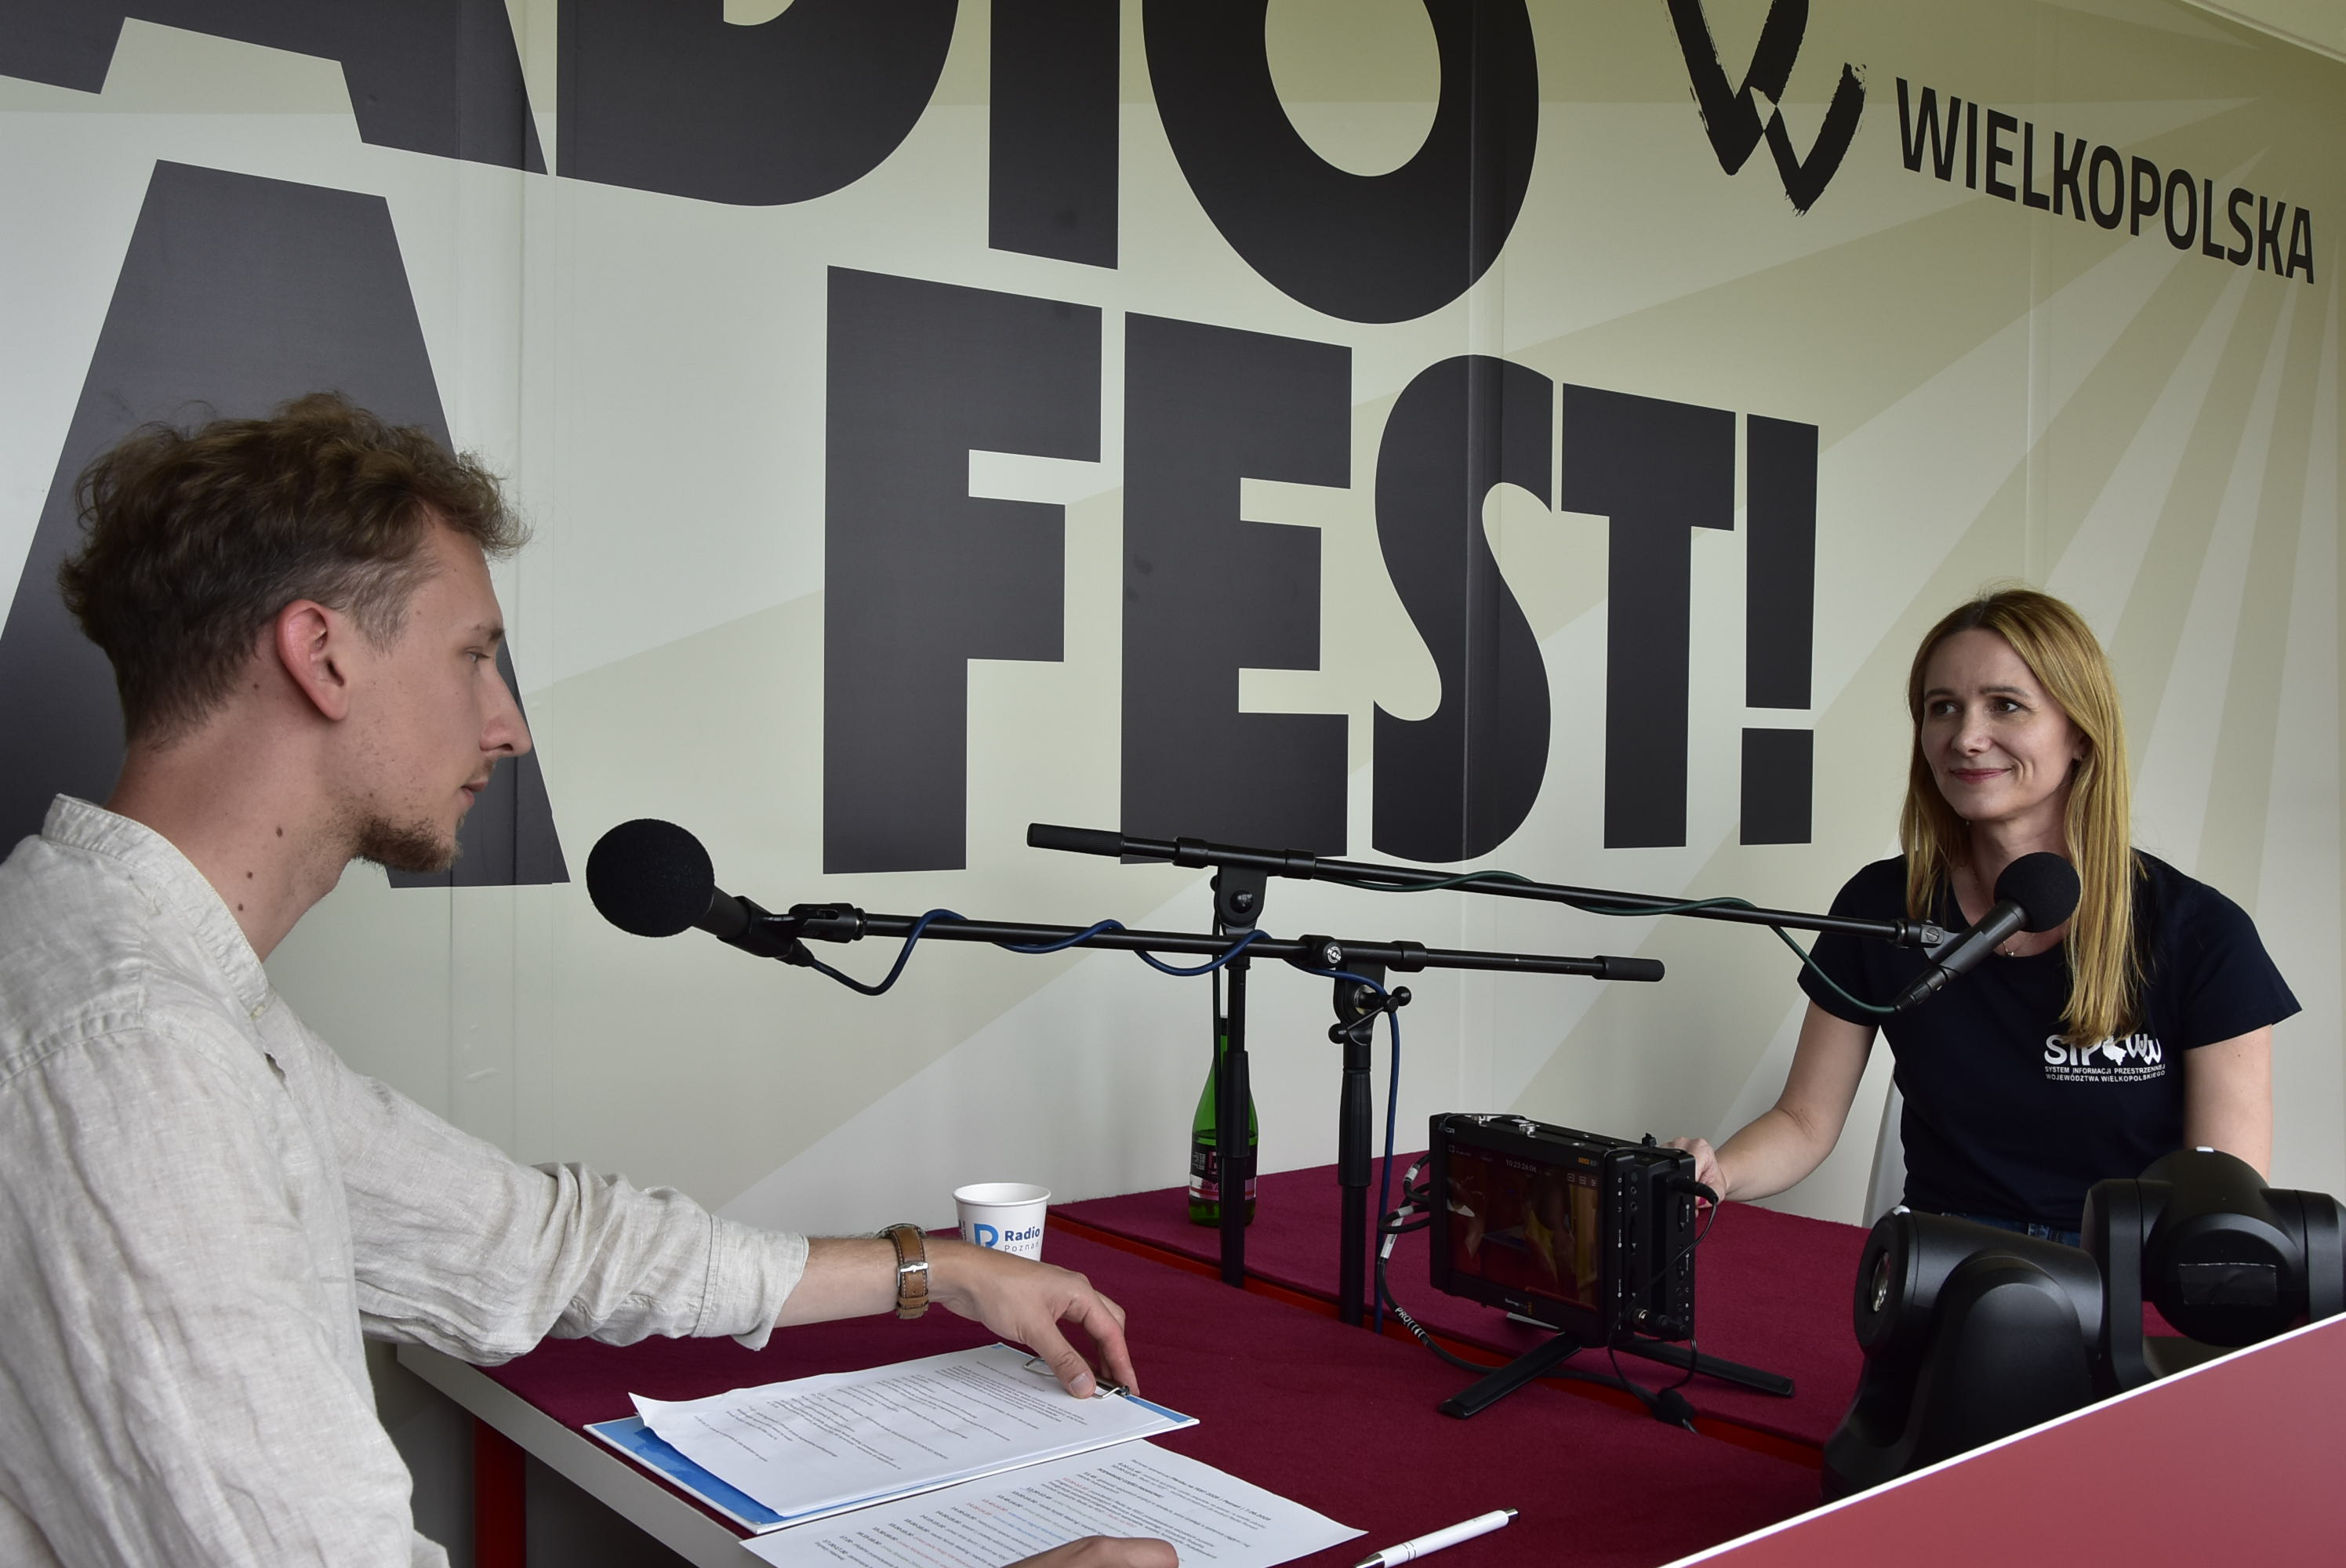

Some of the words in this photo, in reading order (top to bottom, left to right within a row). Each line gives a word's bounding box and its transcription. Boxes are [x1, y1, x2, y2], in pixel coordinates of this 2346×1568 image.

[1895, 77, 2314, 284] WIELKOPOLSKA
[823, 267, 1820, 873] FEST!
[2046, 1073, 2099, 1082] WOJEWÓDZTWA
[2101, 1070, 2166, 1083] WIELKOPOLSKIEGO
[2114, 1064, 2166, 1075] PRZESTRZENNEJ
[1004, 1226, 1040, 1242] Radio
